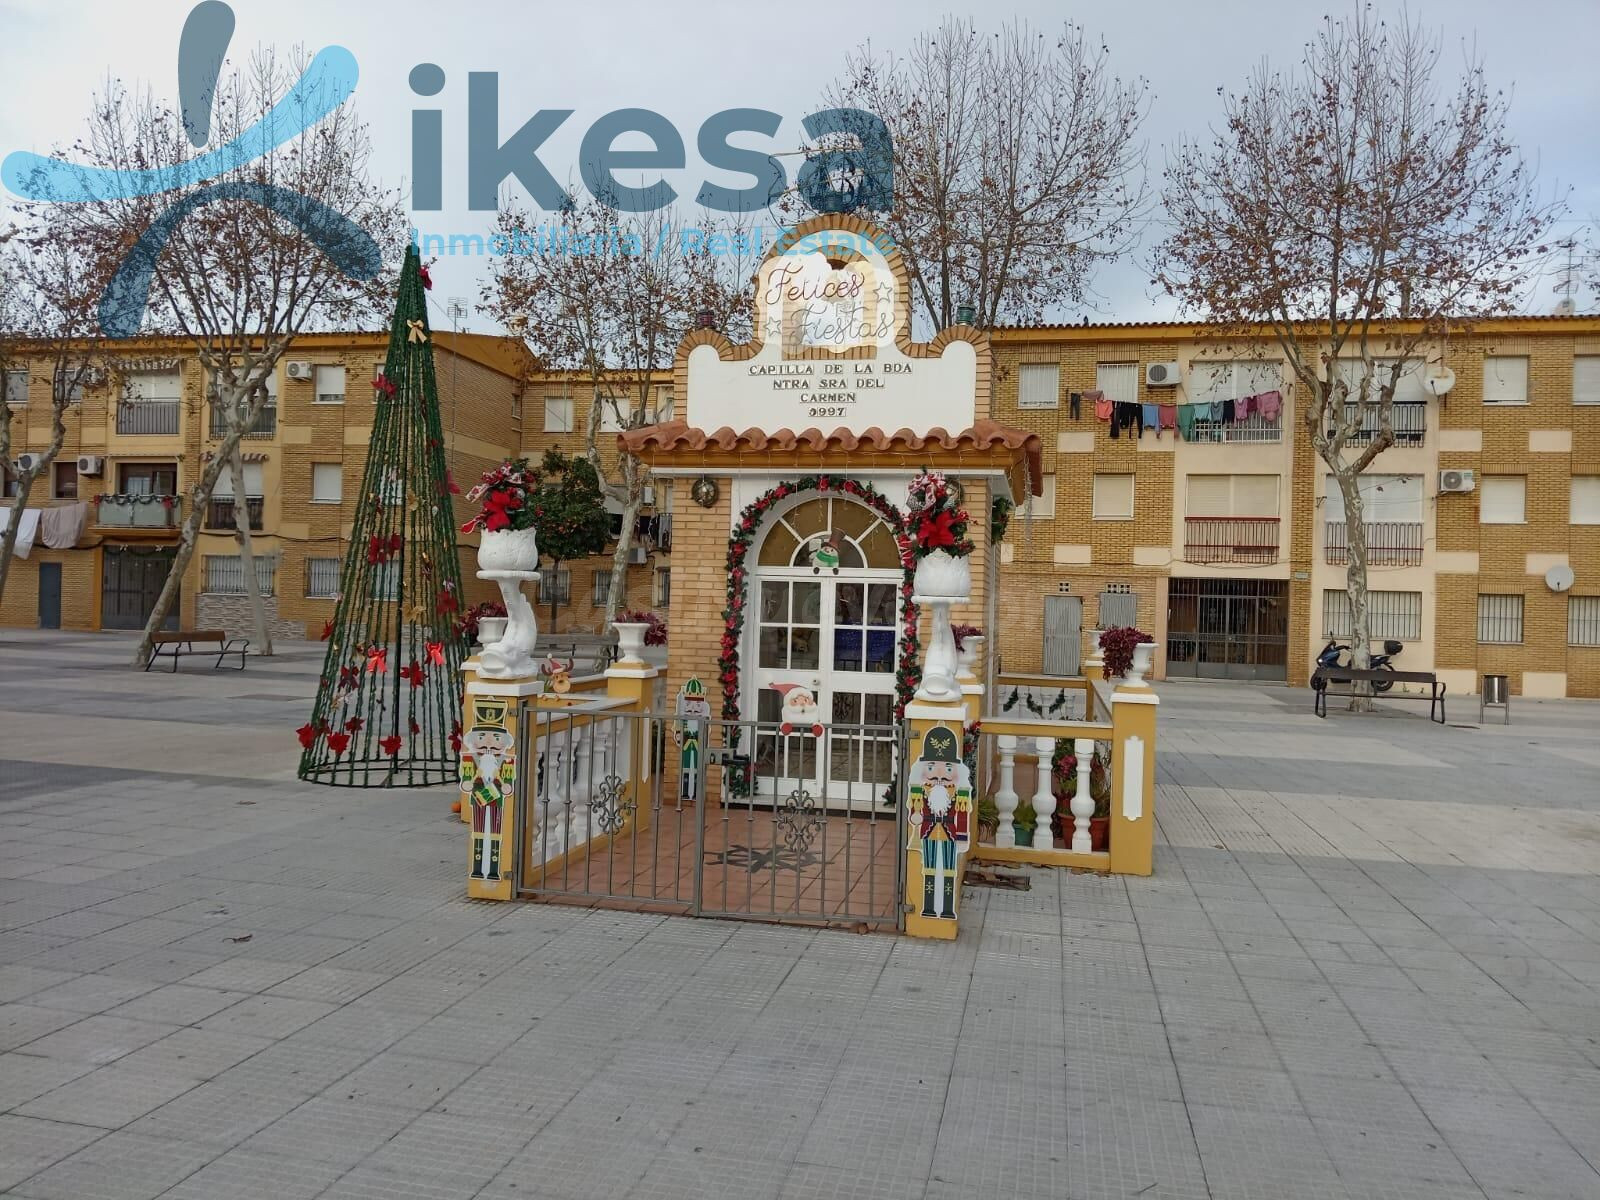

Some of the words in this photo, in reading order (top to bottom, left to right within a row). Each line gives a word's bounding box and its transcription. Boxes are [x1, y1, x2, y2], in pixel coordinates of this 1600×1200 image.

[765, 262, 865, 305] Felices
[790, 302, 895, 345] Fiestas
[748, 364, 814, 375] CAPILLA
[823, 364, 843, 374] DE
[854, 363, 873, 373] LA
[883, 363, 913, 373] BDA
[773, 379, 810, 390] NTRA
[819, 379, 848, 389] SRA
[856, 378, 885, 389] DEL
[800, 393, 856, 403] CARMEN
